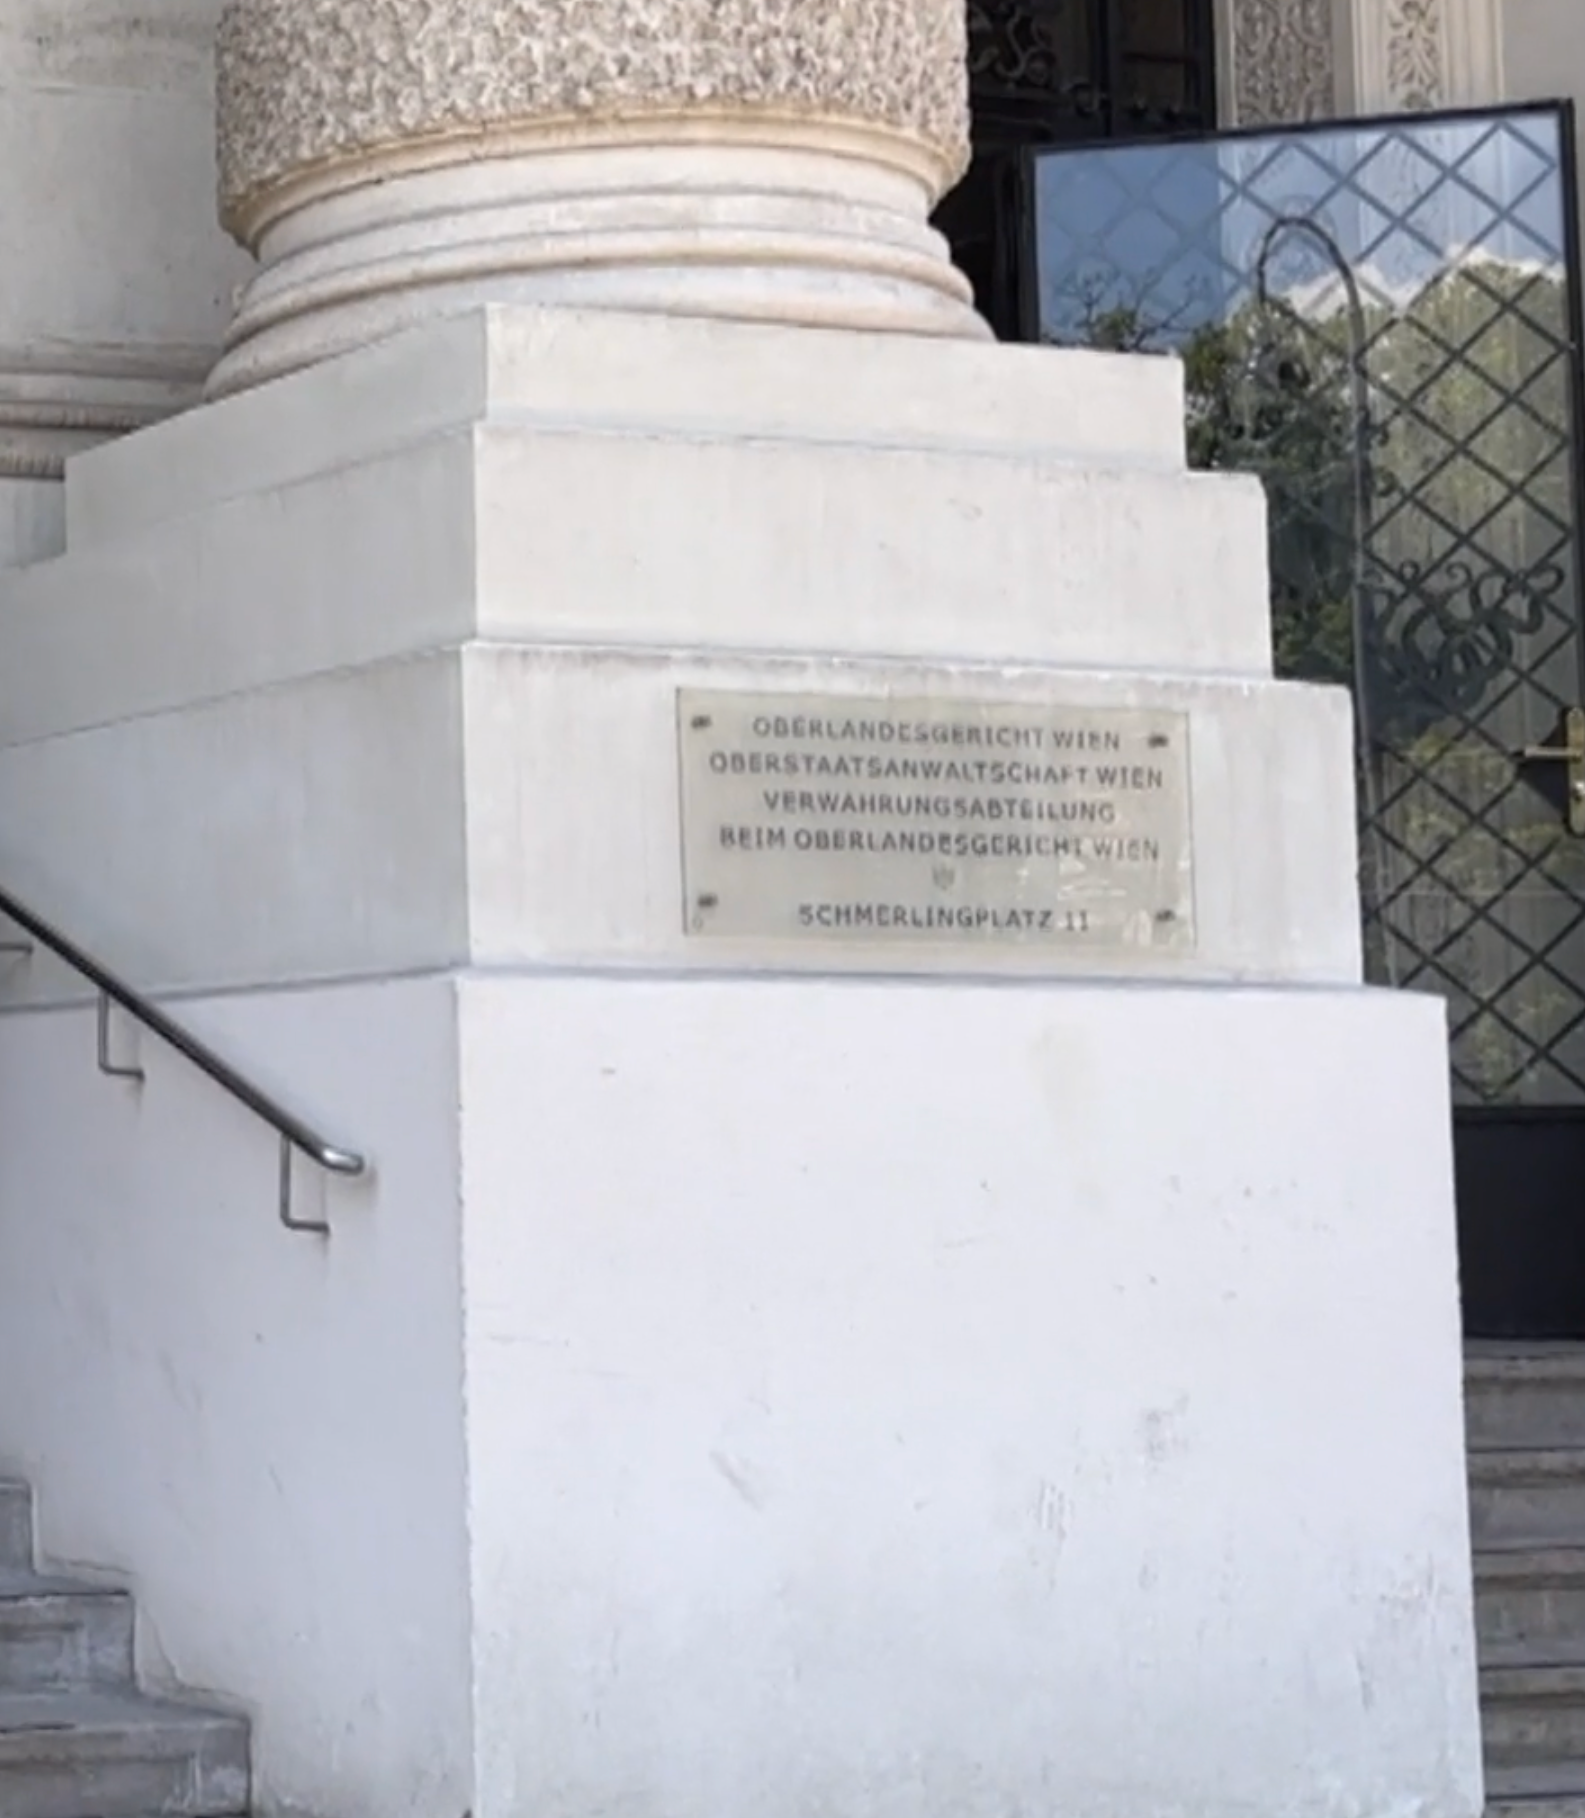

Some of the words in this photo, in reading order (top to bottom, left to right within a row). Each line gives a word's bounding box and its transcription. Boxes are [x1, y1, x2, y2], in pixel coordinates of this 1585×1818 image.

[752, 715, 1043, 748] OBERLANDESGERICHT
[1052, 729, 1120, 751] WIEN
[709, 751, 1087, 786] OBERSTAATSANWALTSCHAFT
[1095, 765, 1163, 788] WIEN
[763, 790, 1115, 823] VERWAHRUNGSABTEILUNG
[719, 825, 786, 848] BEIM
[793, 828, 1084, 857] OBERLANDESGERICHT
[1092, 837, 1159, 860] WIEN
[798, 903, 1053, 929] SCHMERLINGPLATZ
